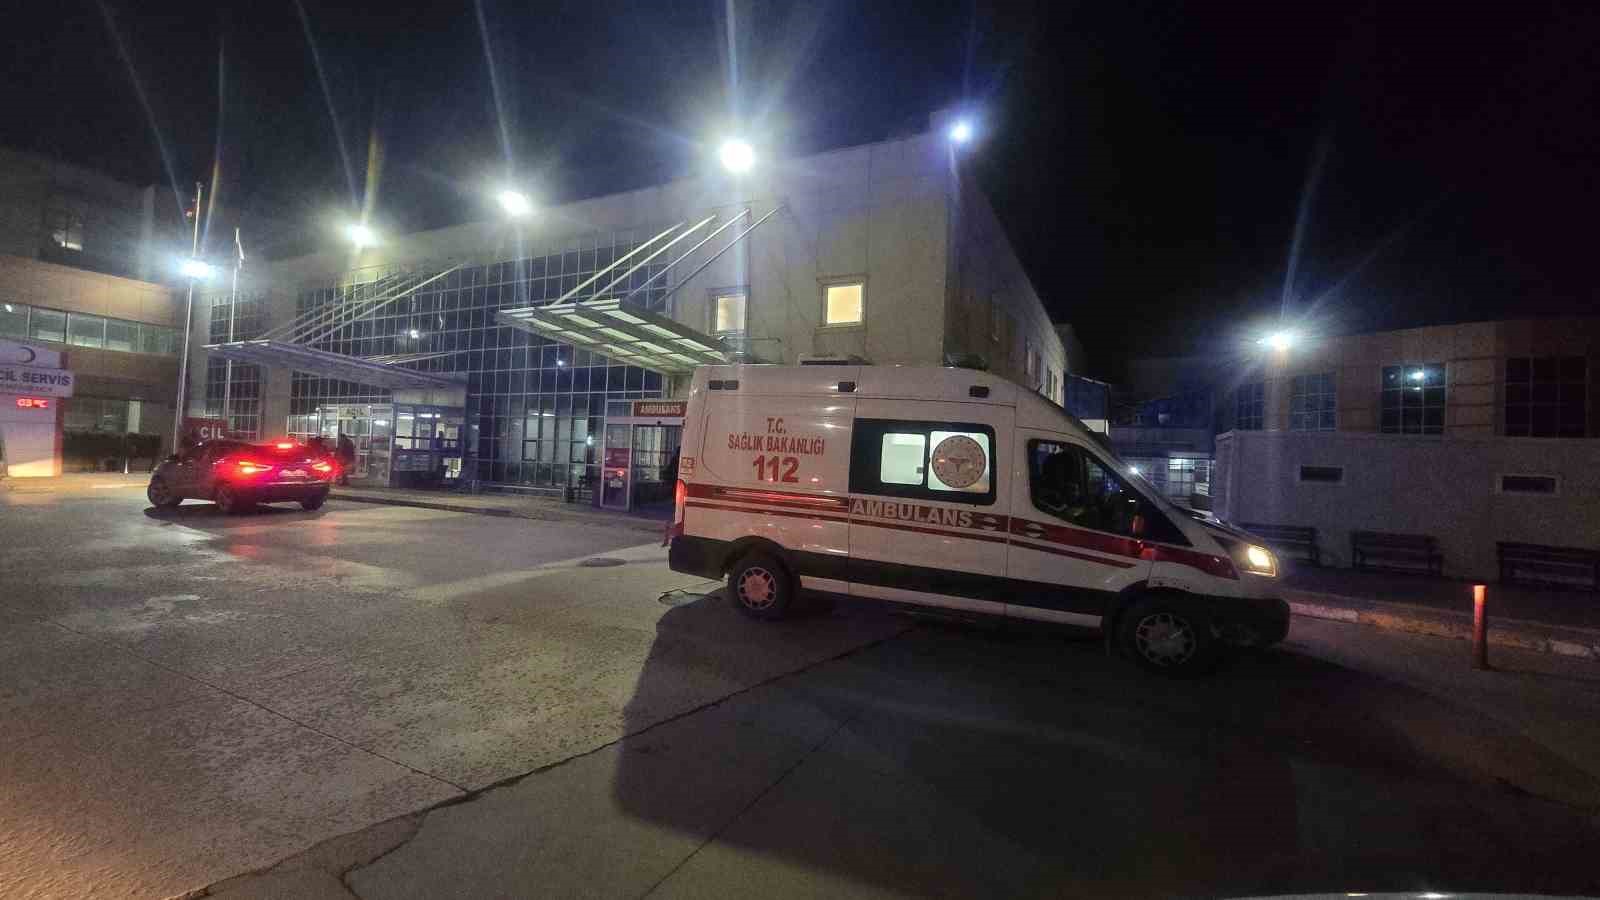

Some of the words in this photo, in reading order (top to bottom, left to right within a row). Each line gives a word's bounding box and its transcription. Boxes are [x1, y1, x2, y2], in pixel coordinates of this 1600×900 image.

[21, 371, 72, 386] SERVİS
[727, 432, 764, 451] SAĞLIK
[766, 435, 825, 456] BAKANLIĞI
[753, 455, 799, 483] 112
[852, 499, 974, 528] AMBULANS
